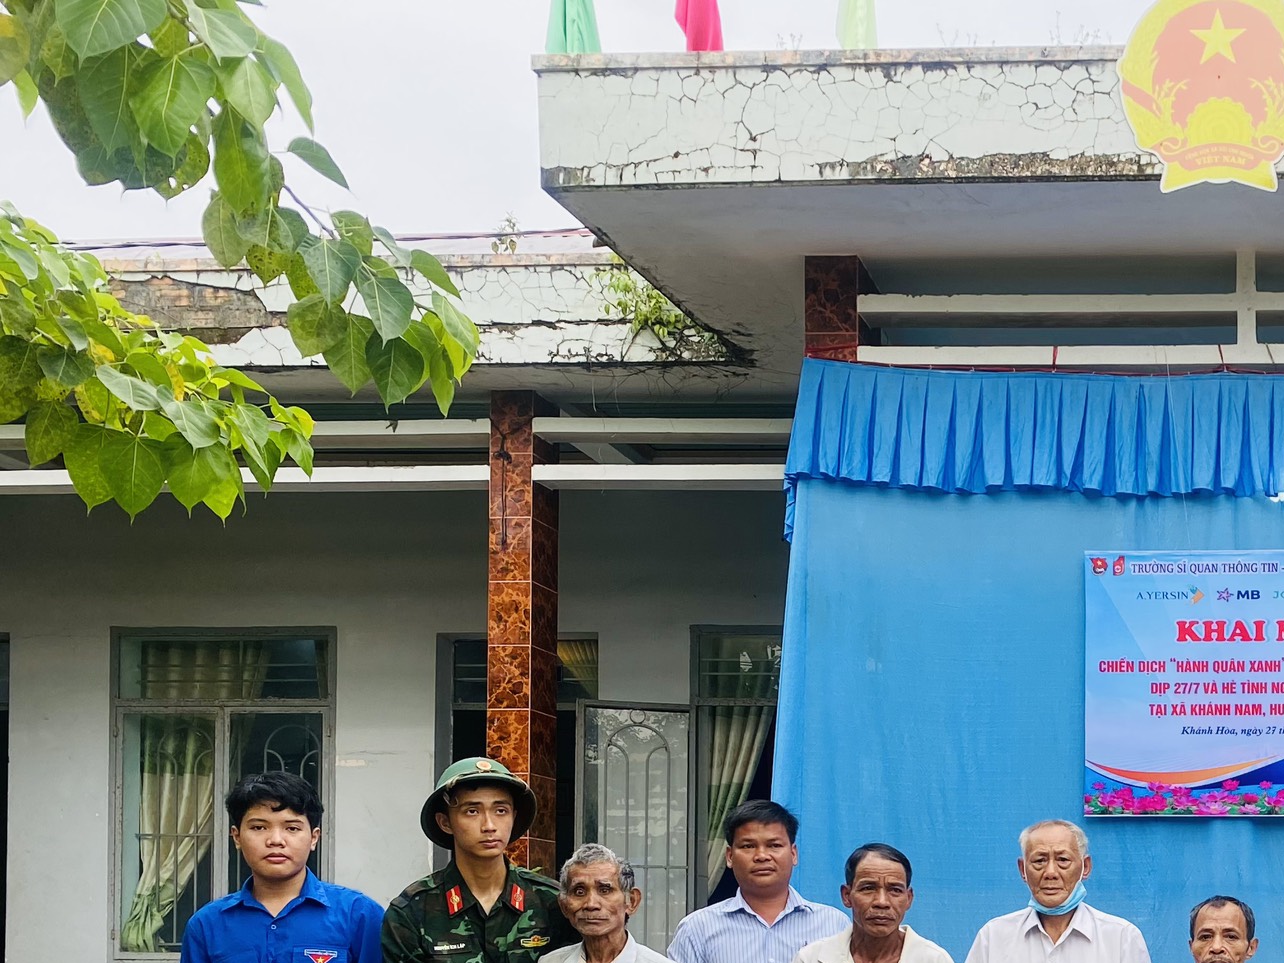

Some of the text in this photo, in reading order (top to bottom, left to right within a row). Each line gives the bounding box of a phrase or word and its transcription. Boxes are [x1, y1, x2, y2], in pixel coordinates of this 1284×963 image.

[1131, 560, 1174, 574] TRƯỜNG
[1177, 560, 1187, 573] SĨ
[1189, 562, 1218, 574] QUAN
[1222, 560, 1258, 573] THÔNG
[1260, 562, 1278, 573] TIN
[1136, 591, 1188, 600] A.YERSIN
[1237, 590, 1261, 599] MB
[1176, 620, 1265, 642] KHAI
[1099, 656, 1135, 673] CHIẾN
[1138, 660, 1166, 675] DỊCH
[1212, 657, 1245, 674] QUÂN
[1151, 682, 1171, 697] DỊP
[1174, 682, 1200, 695] 27/7
[1203, 680, 1218, 694] VÀ
[1222, 680, 1236, 694] HÈ
[1240, 679, 1267, 694] TÌNH
[1149, 703, 1167, 718] TẠI
[1171, 701, 1187, 716] XÃ
[1190, 701, 1231, 716] KHÁNH
[1234, 703, 1266, 717] NAM,
[1181, 726, 1213, 735] Khánh
[1215, 726, 1238, 736] Hòa,
[1240, 726, 1263, 737] ngày
[1265, 726, 1277, 735] 27
